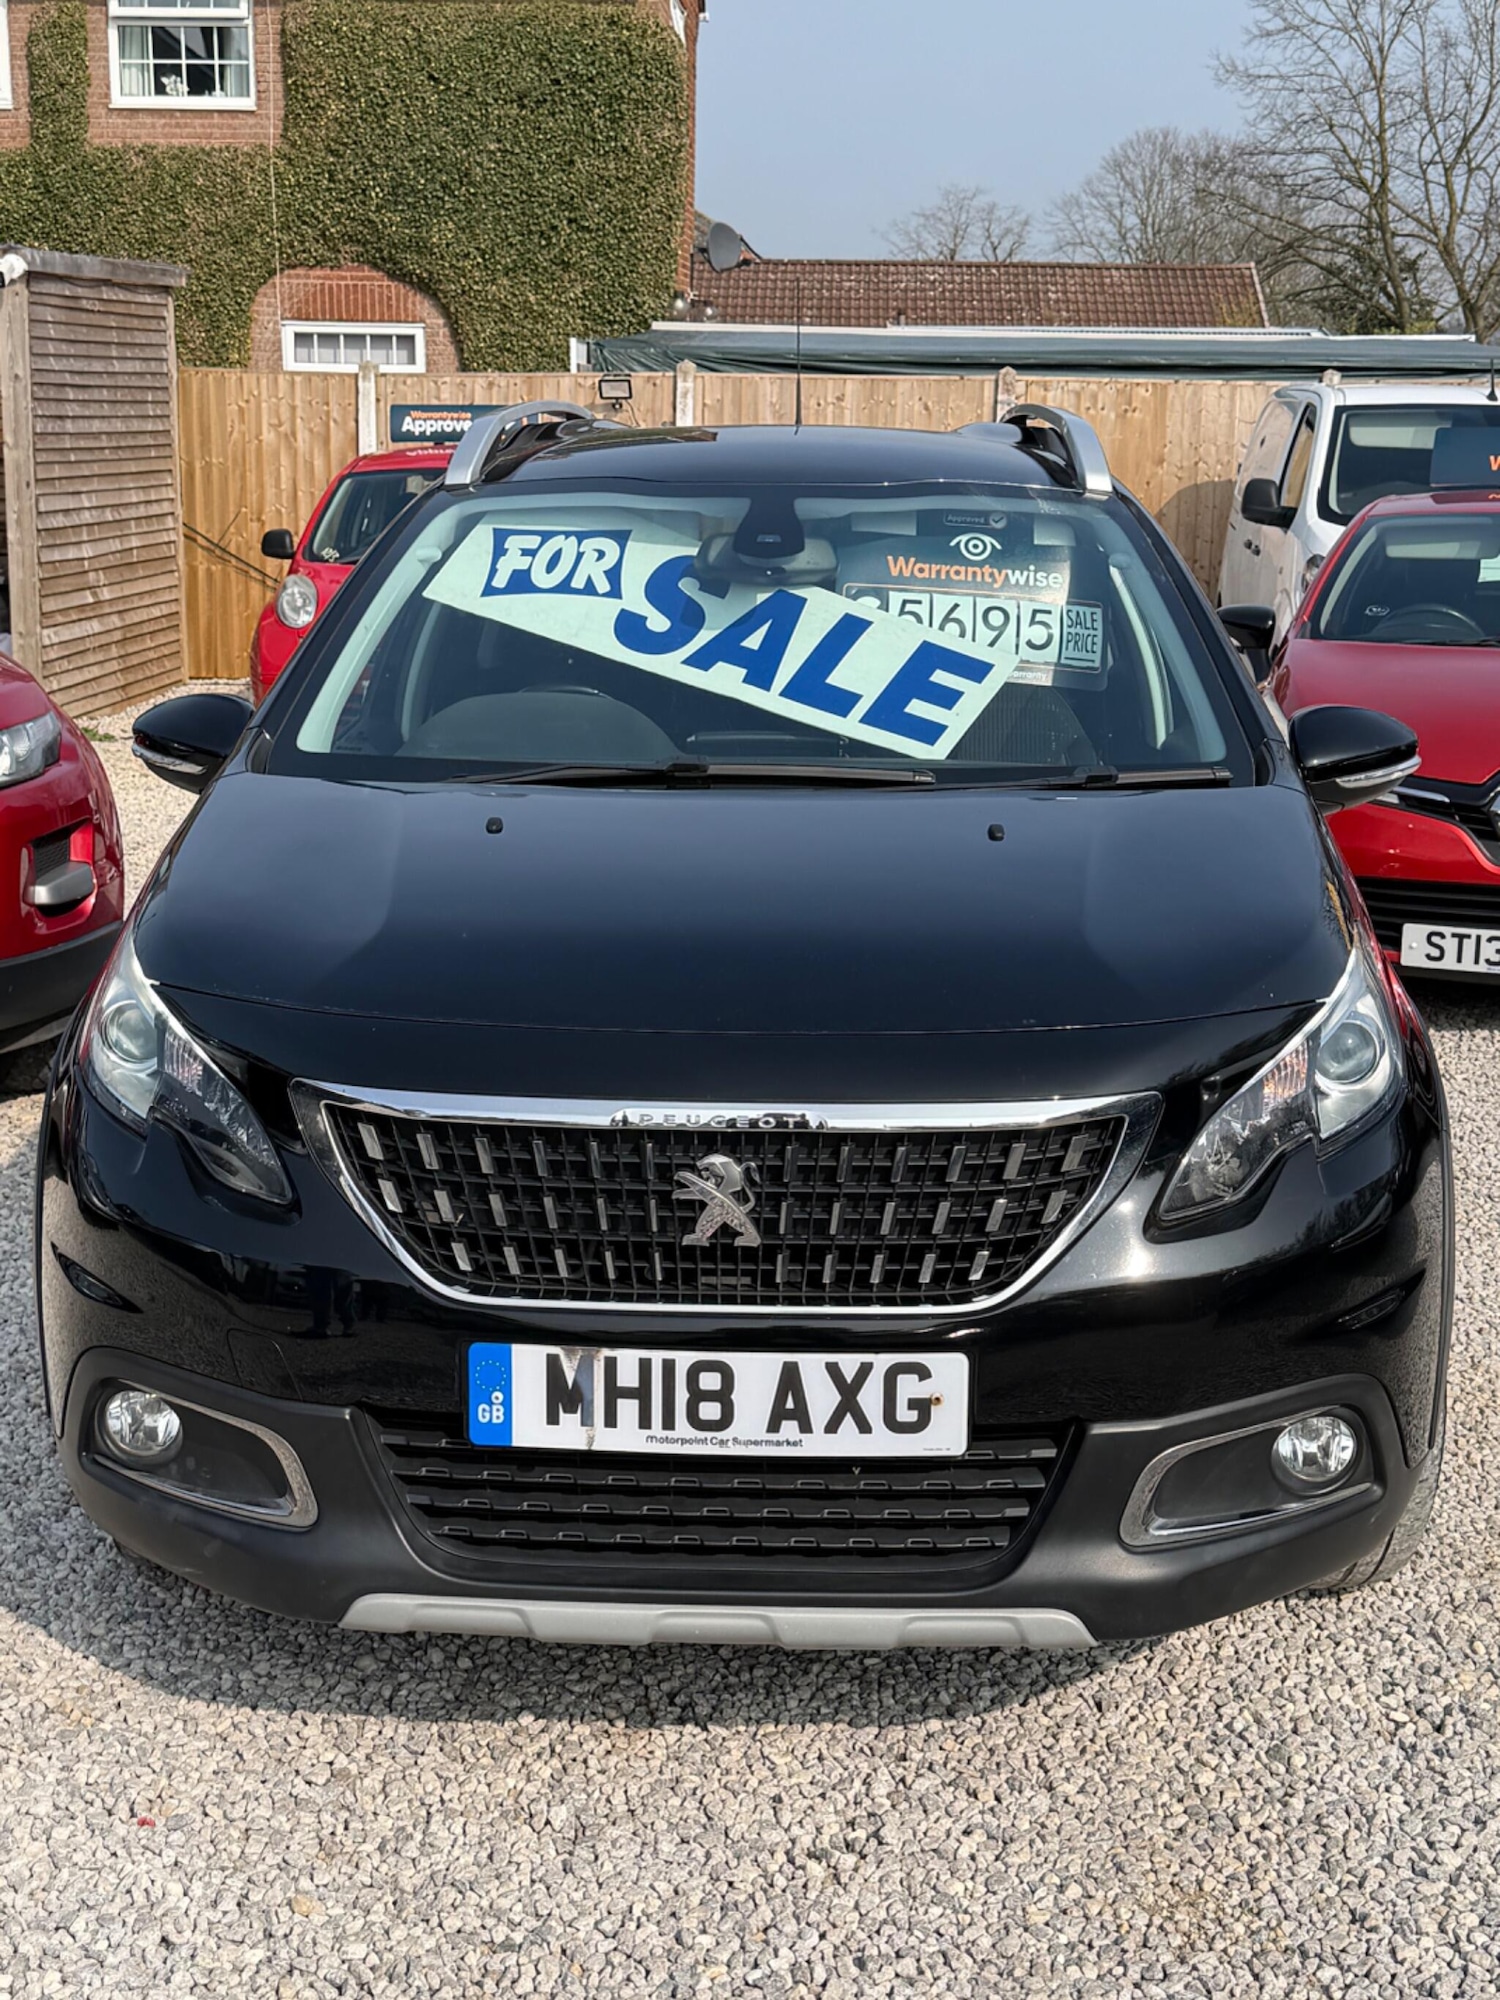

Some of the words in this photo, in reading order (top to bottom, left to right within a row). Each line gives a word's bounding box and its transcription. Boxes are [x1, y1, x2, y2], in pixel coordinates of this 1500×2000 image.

[401, 416, 473, 436] Approve
[887, 555, 1064, 588] Warrantywise
[857, 595, 1054, 651] 5695
[1065, 608, 1098, 632] SALE
[492, 533, 610, 596] FOR
[613, 554, 996, 747] SALE
[1065, 631, 1098, 654] PRICE
[1008, 670, 1048, 681] arranty
[1425, 930, 1500, 967] ST13
[638, 1113, 801, 1129] PEUGEOT
[546, 1353, 735, 1433] MH18
[765, 1361, 933, 1435] AXG
[477, 1403, 505, 1424] GB
[709, 1436, 731, 1447] Car
[732, 1436, 804, 1448] Supermarket
